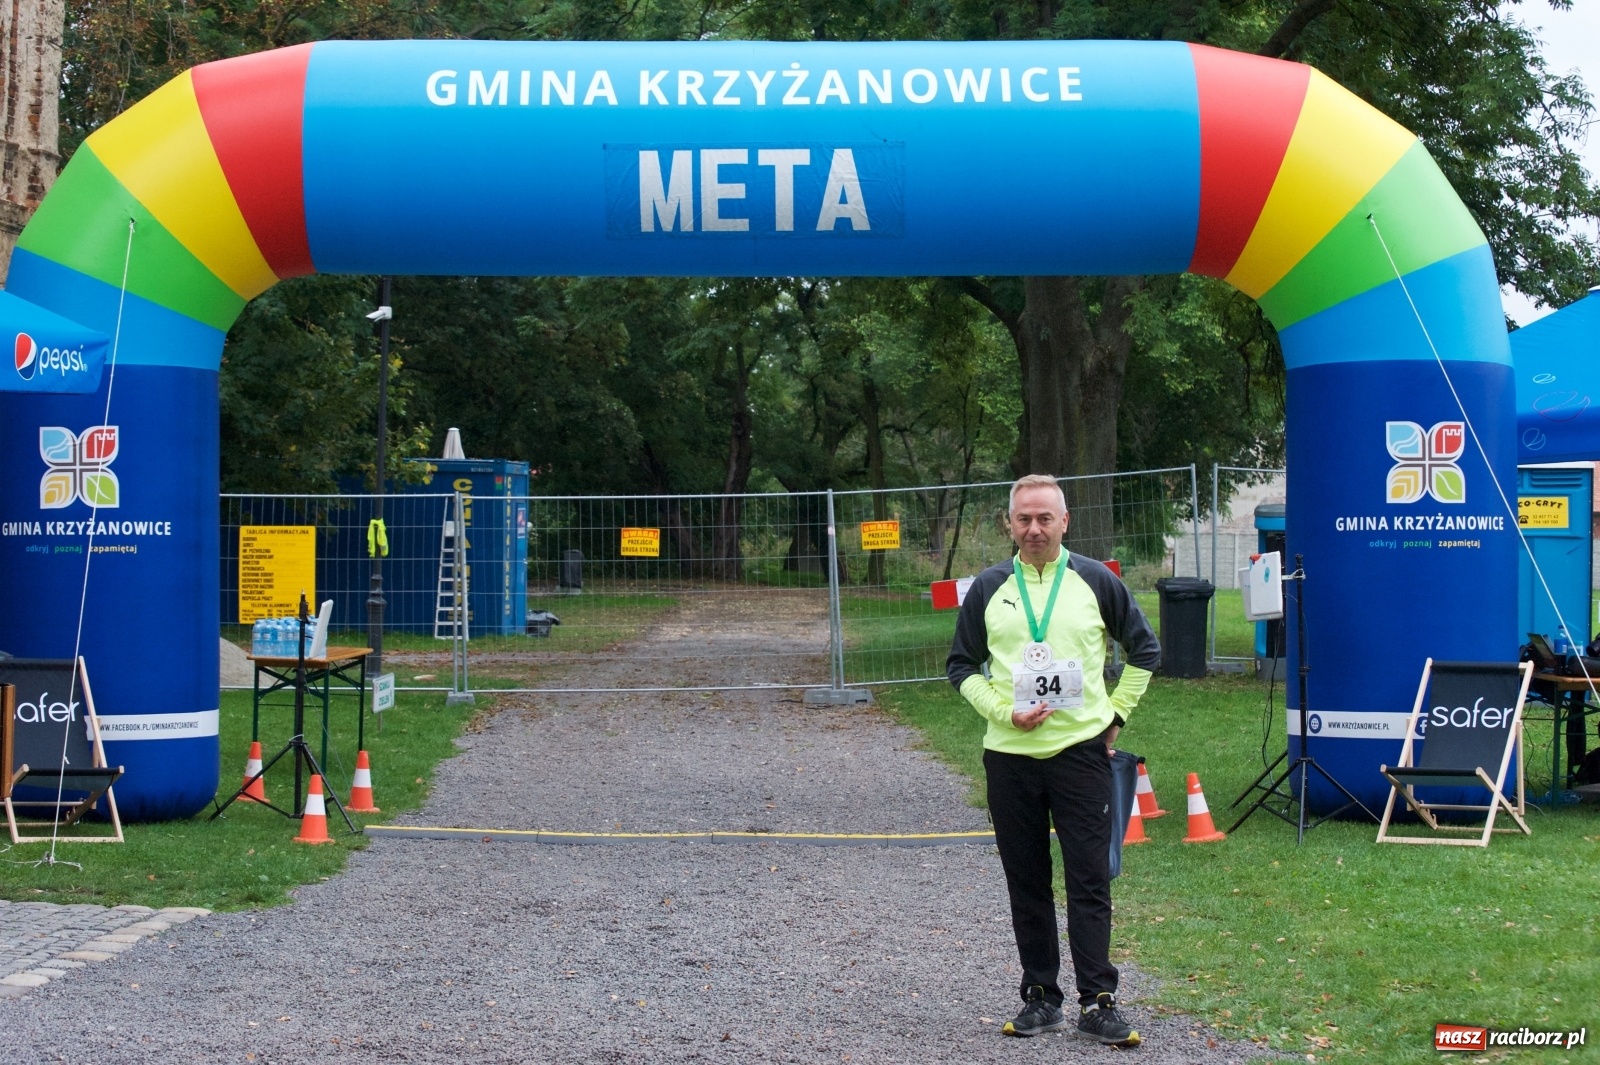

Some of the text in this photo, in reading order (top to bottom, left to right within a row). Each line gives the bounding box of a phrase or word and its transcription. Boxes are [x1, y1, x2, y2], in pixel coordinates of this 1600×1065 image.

[425, 61, 1083, 107] GMINA KRZYŻANOWICE
[638, 148, 871, 233] META
[39, 344, 84, 376] pepsi
[2, 518, 171, 536] GMINA KRZYŻANOWICE
[1336, 513, 1504, 531] GMINA KRZYŻANOWICE
[26, 544, 49, 554] odkryj
[54, 544, 82, 554] poznaj
[1369, 538, 1481, 549] odkryj poznaj zapamiętaj
[1035, 675, 1062, 697] 34
[14, 692, 80, 723] afer
[1430, 697, 1513, 729] safer
